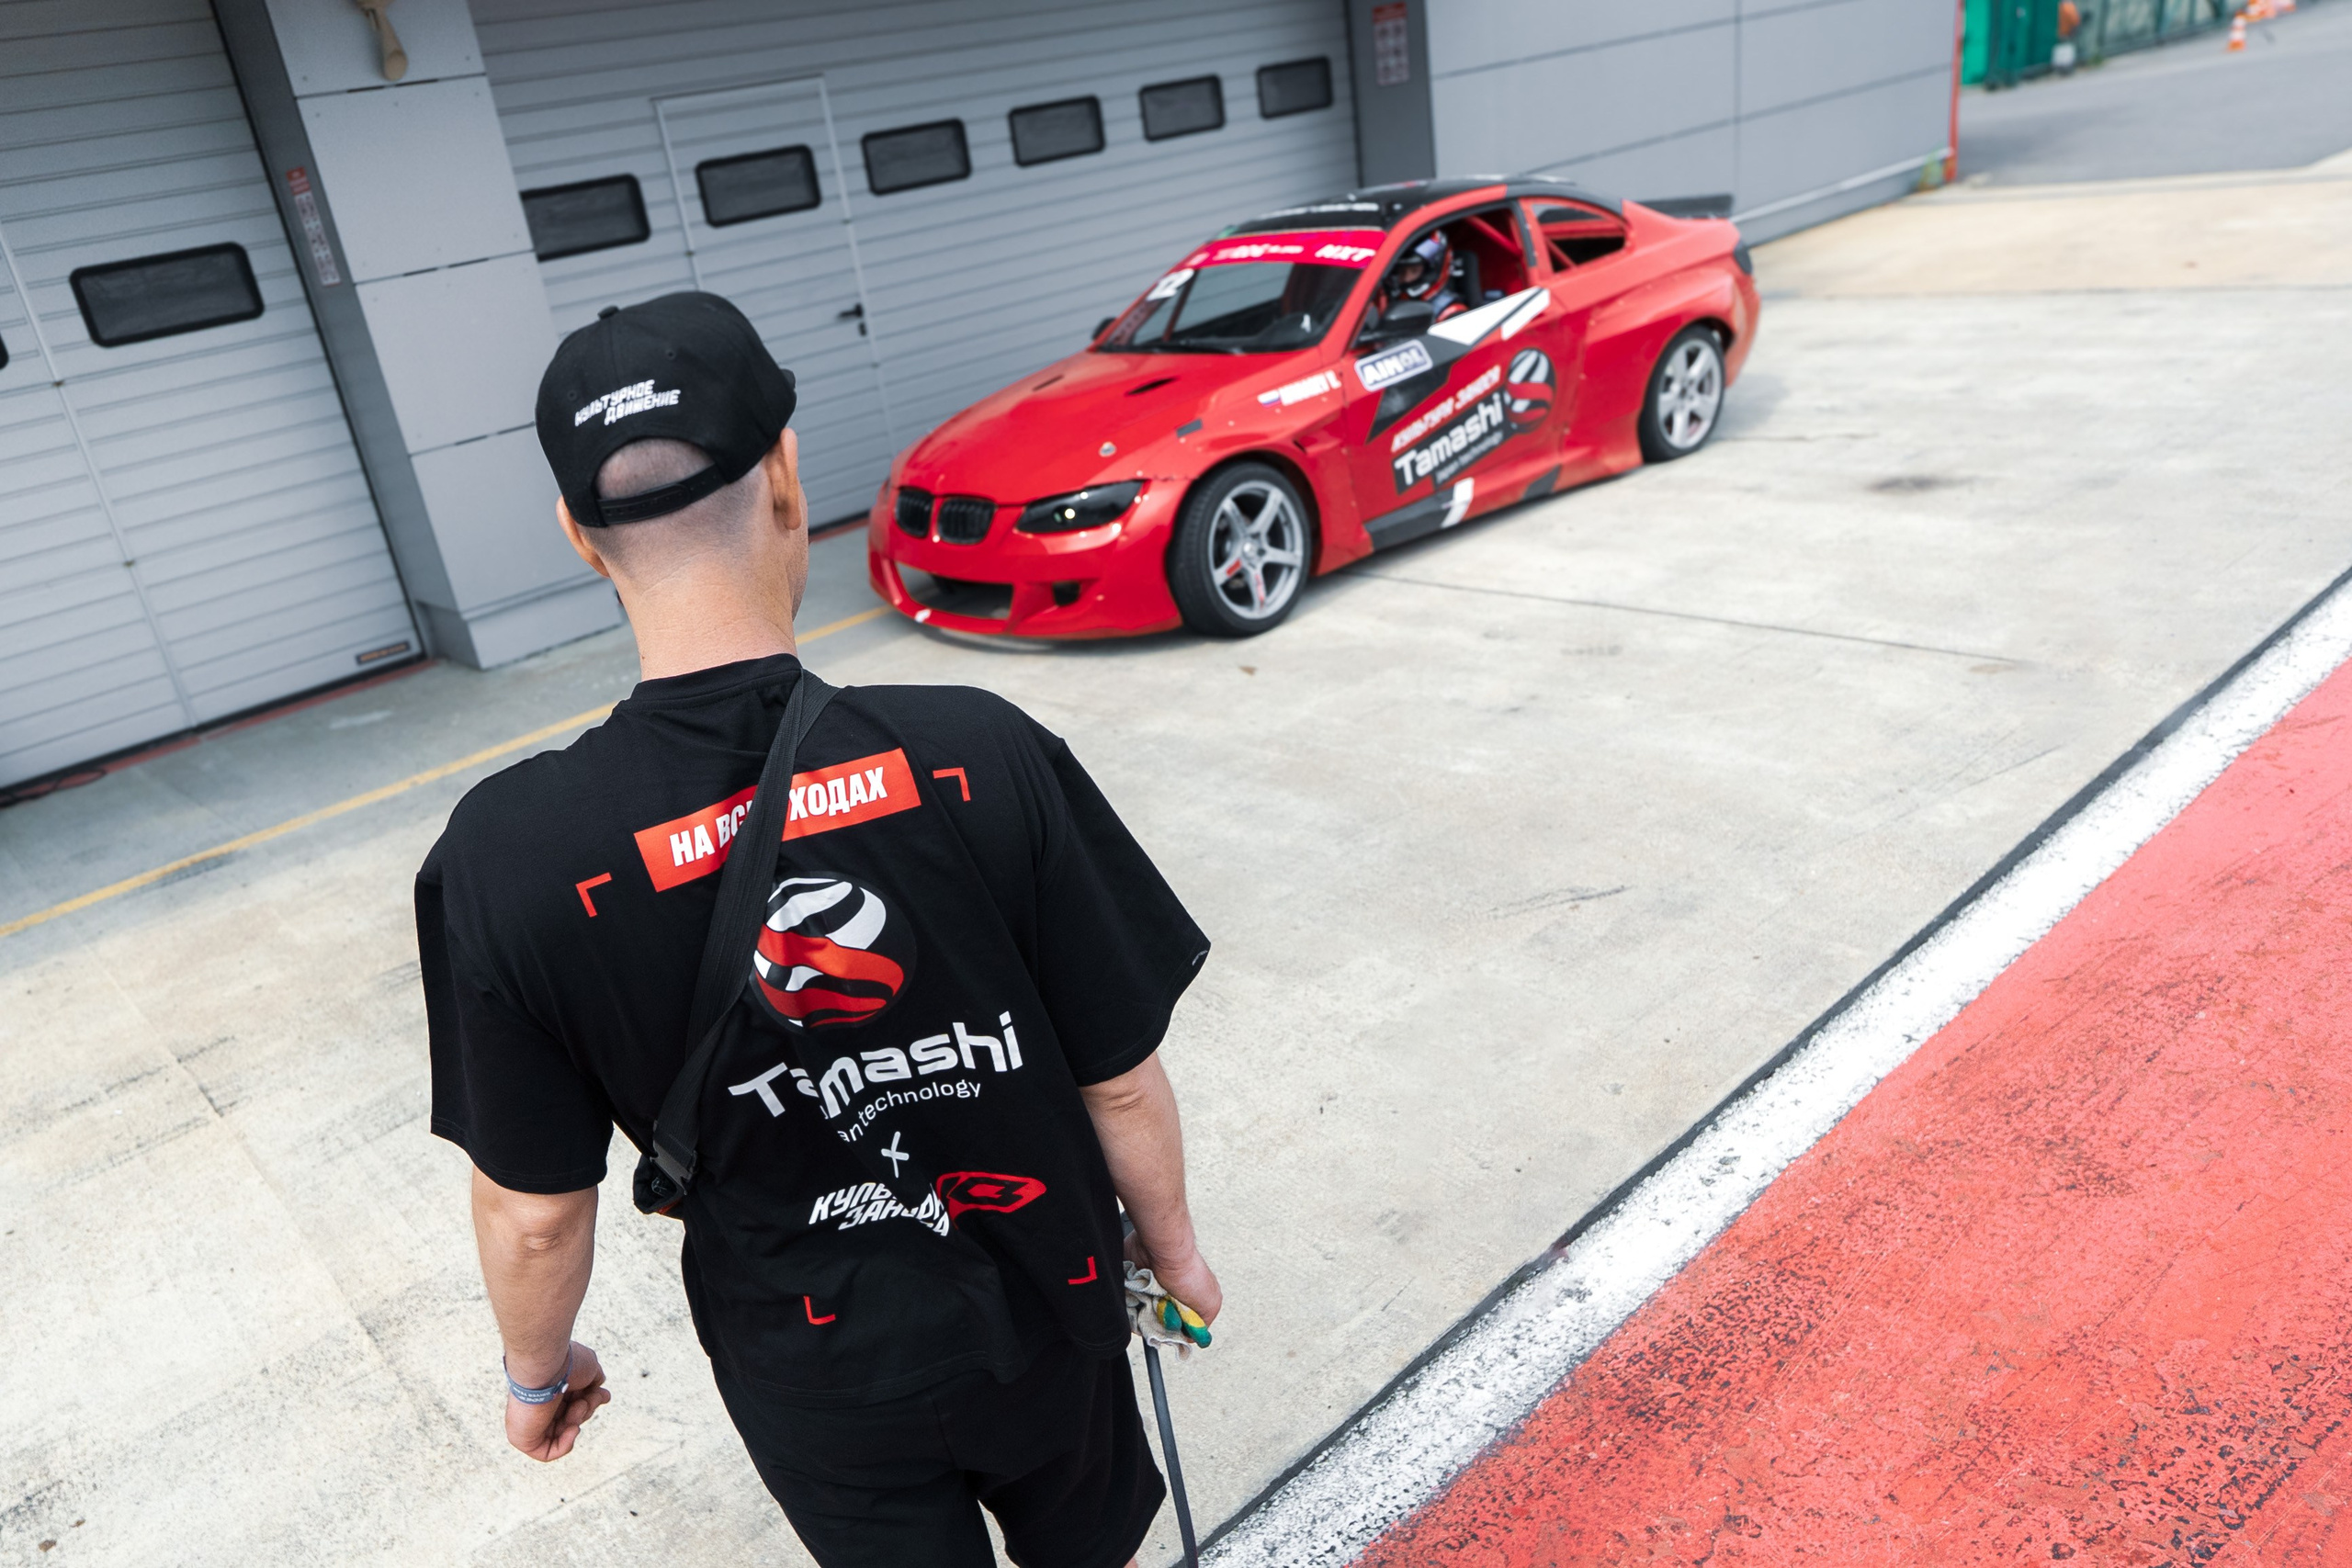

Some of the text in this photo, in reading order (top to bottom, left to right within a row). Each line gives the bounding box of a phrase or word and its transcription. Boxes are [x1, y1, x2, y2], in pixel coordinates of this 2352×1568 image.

[575, 379, 655, 426] КУЛЬТУРНОЕ
[604, 389, 681, 425] ДВИЖЕНИЕ
[1394, 392, 1503, 486] Tamashi
[669, 824, 716, 867] НА
[789, 767, 888, 821] ХОДАХ
[729, 1011, 1023, 1118] Tamashi
[857, 1079, 981, 1127] technology
